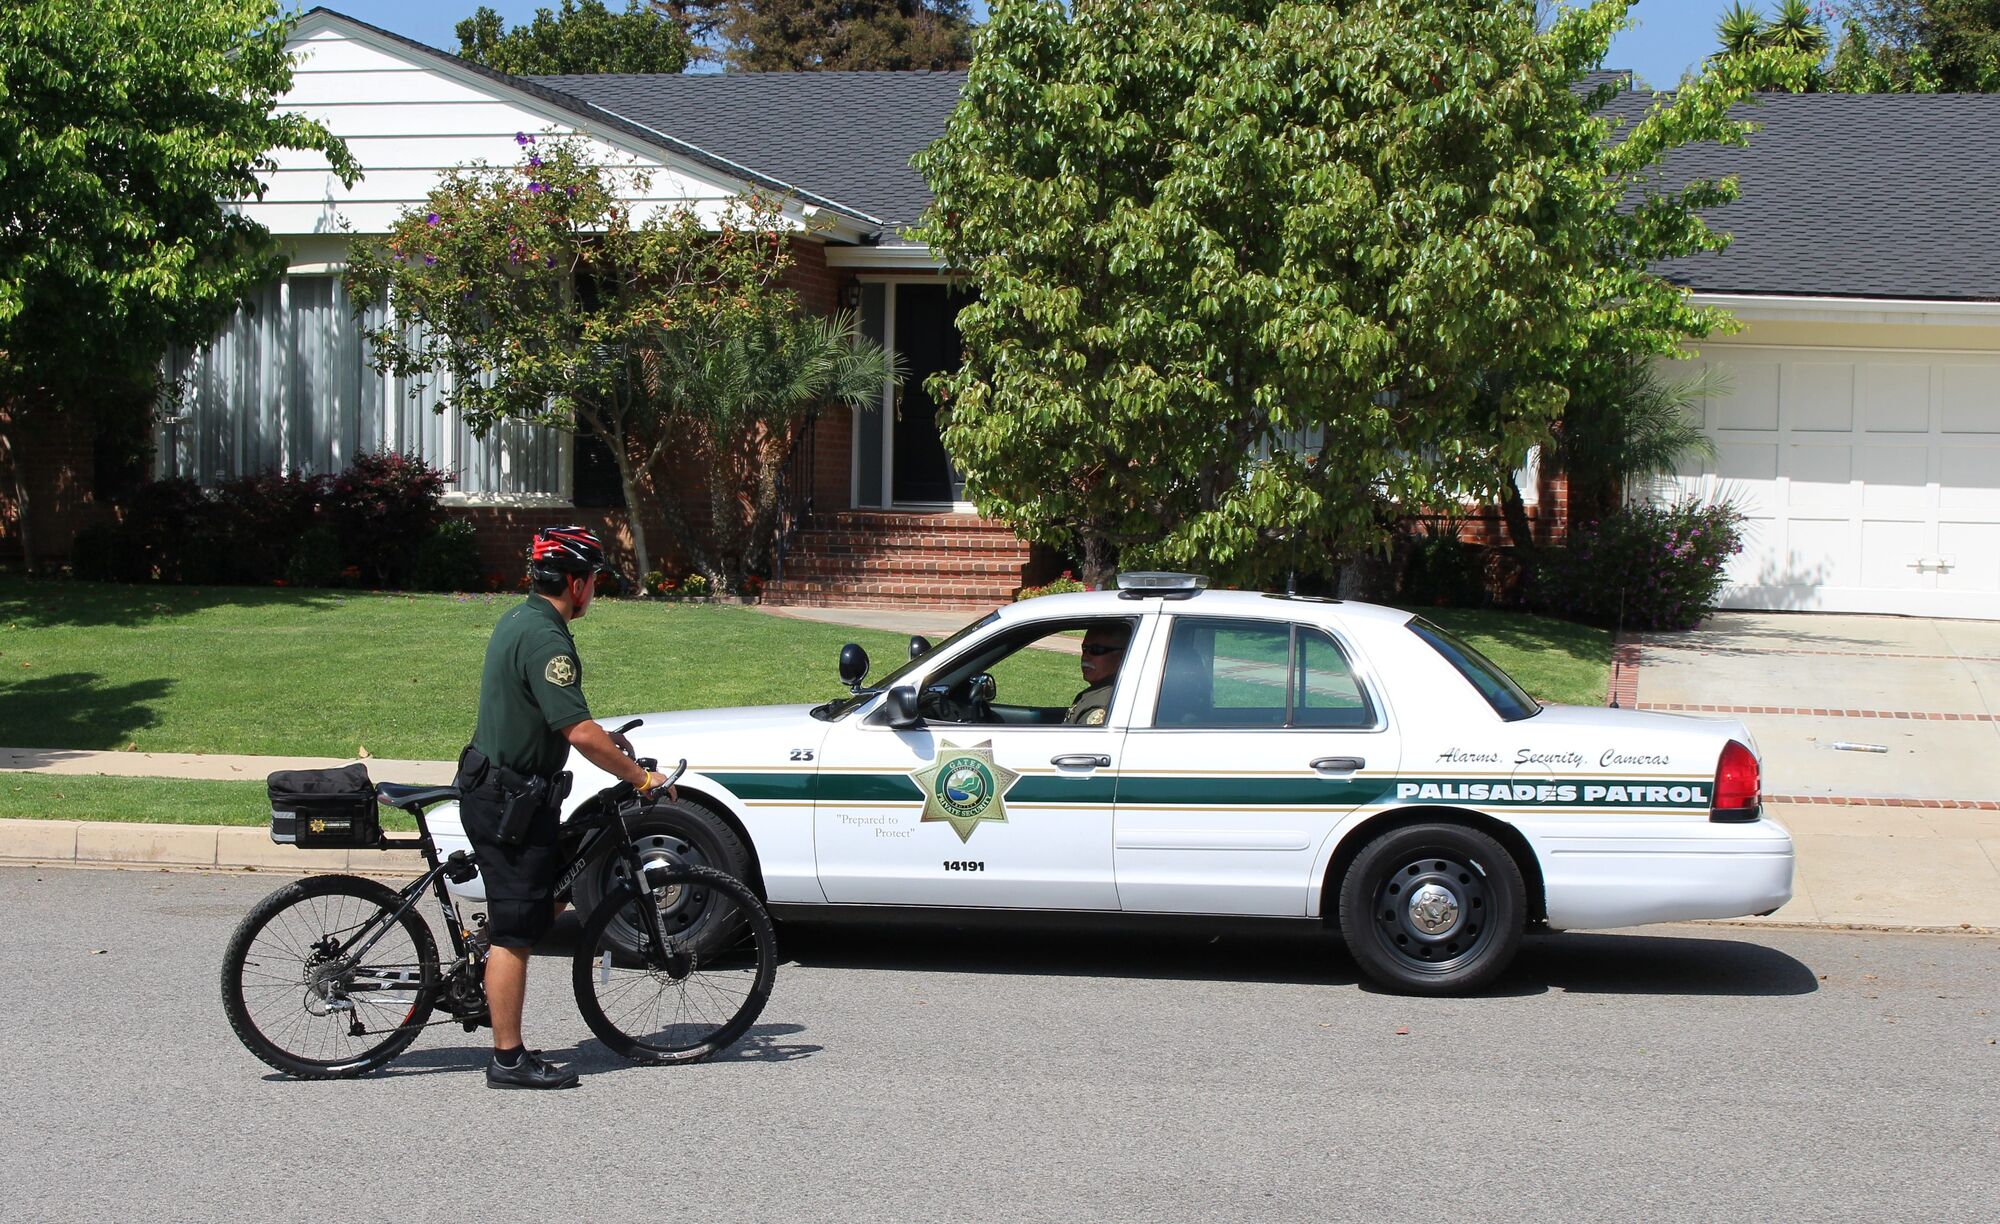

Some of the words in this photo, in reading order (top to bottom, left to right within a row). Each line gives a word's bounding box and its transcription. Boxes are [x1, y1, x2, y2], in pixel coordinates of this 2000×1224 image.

[790, 748, 814, 761] 23
[1599, 748, 1671, 767] Cameras
[949, 759, 982, 769] GATES
[1397, 783, 1577, 802] PALISADES
[1584, 785, 1708, 803] PATROL
[937, 792, 961, 815] PRIVATE
[961, 793, 992, 817] SECURITY
[836, 813, 885, 827] "Prepared
[888, 815, 899, 825] to
[875, 827, 915, 838] Protect"
[943, 861, 985, 872] 14191
